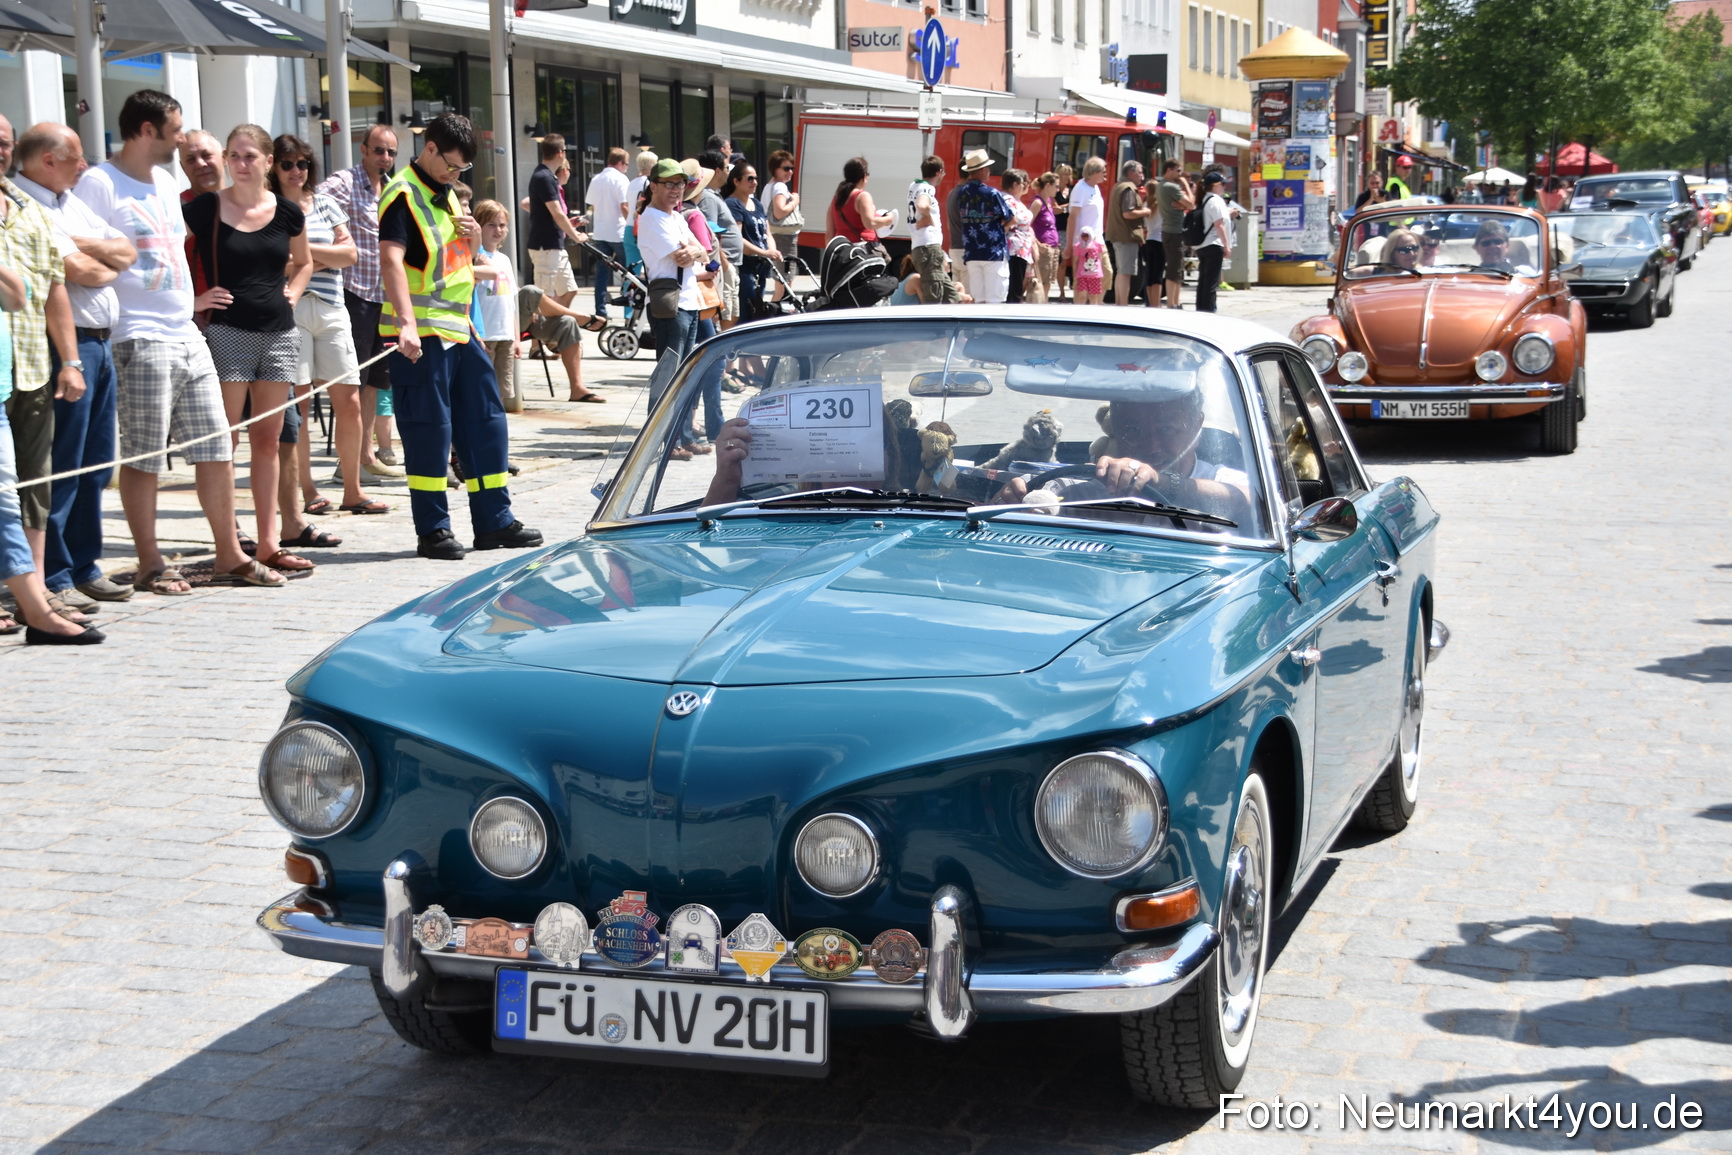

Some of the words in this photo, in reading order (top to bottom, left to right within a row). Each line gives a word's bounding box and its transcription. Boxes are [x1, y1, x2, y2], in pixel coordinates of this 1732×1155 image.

[805, 397, 854, 420] 230
[1380, 402, 1399, 416] NM
[1410, 402, 1427, 416] YM
[1431, 402, 1467, 417] 555H
[606, 927, 649, 941] SCHLOSS
[598, 937, 655, 952] WACHENHEIM
[506, 1011, 518, 1026] D
[529, 980, 596, 1037] FÜ
[633, 988, 702, 1044] NV
[713, 995, 816, 1054] 20H
